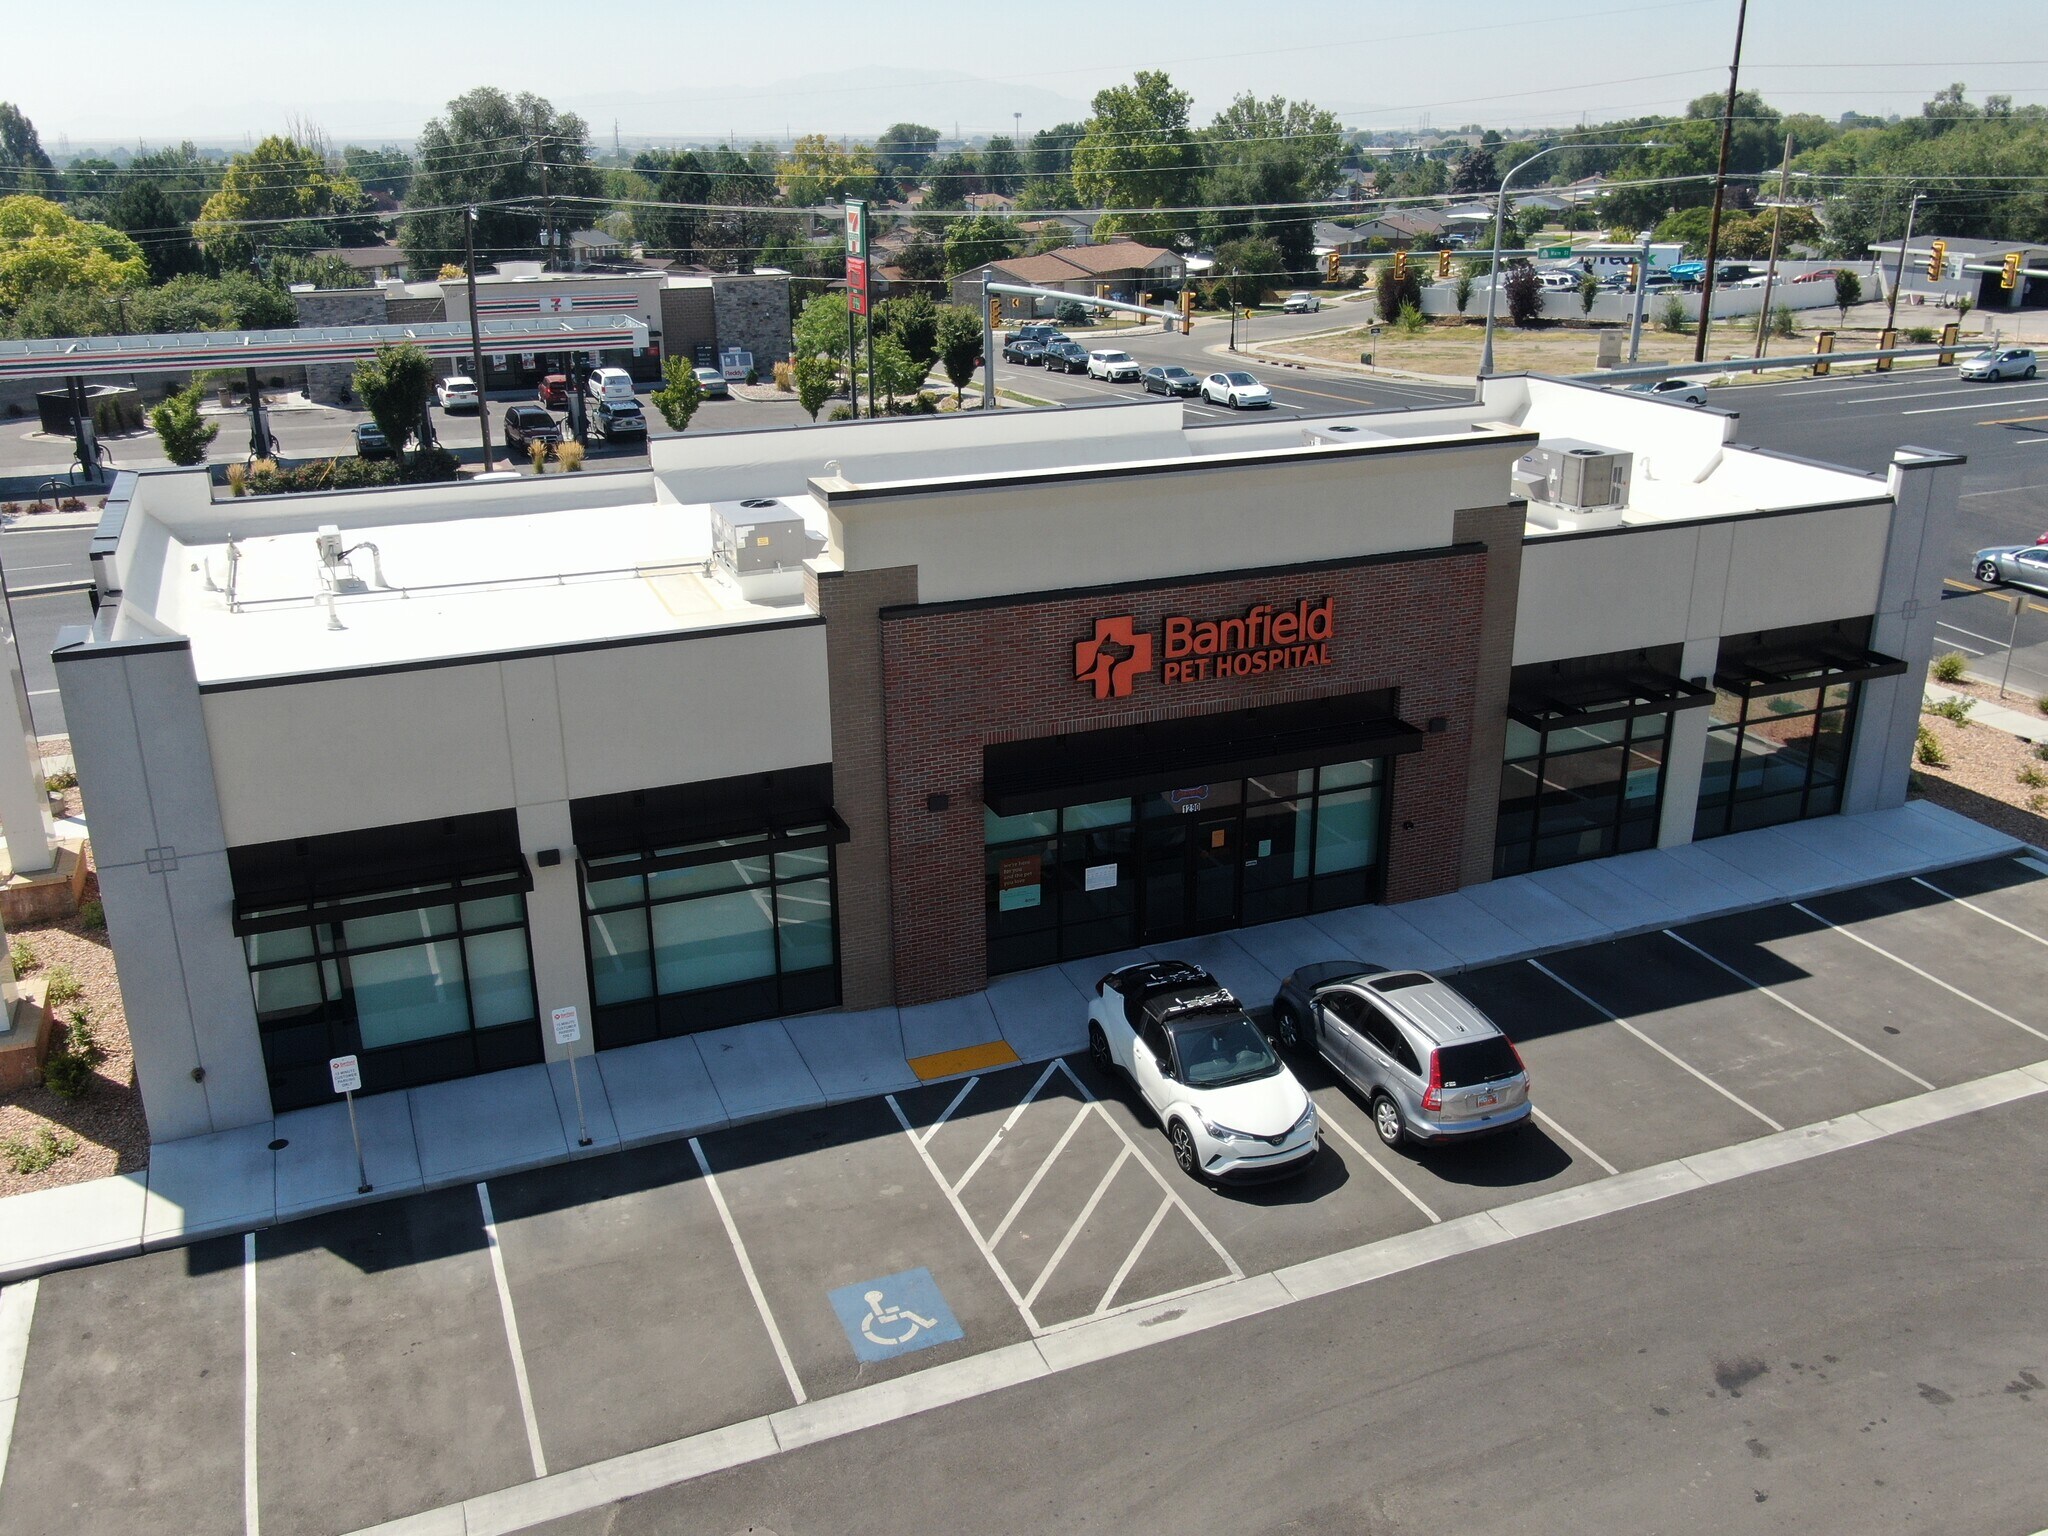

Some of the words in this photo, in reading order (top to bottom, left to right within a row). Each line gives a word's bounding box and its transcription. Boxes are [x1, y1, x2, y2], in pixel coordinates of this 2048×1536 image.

[1164, 597, 1334, 659] Banfield
[1164, 658, 1210, 685] PET
[1216, 643, 1332, 678] HOSPITAL
